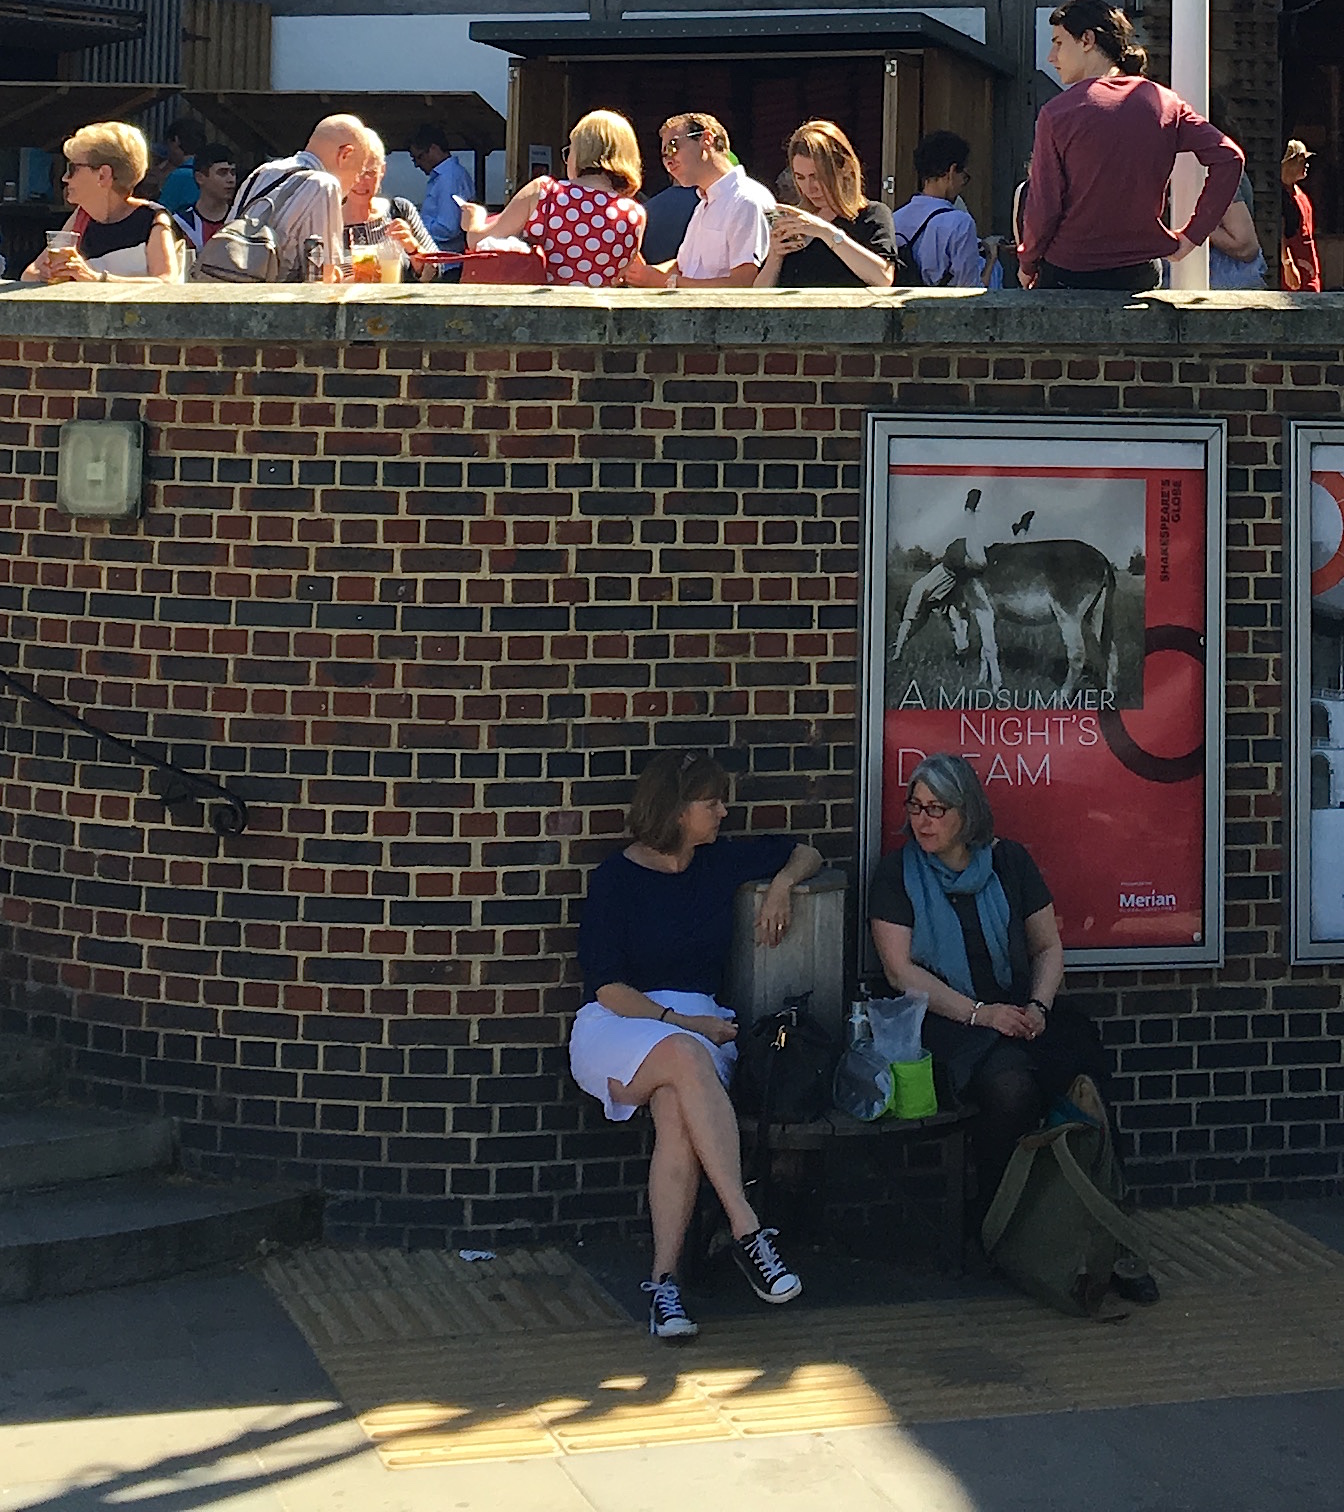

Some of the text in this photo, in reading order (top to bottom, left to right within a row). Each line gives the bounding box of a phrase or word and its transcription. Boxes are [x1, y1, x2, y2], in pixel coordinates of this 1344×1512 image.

[1171, 479, 1182, 523] GLOBE
[1160, 479, 1170, 583] SHAKESPEARE'S
[898, 679, 1116, 712] A MIDSUMMER
[959, 712, 1099, 746] NIGHT'S
[1119, 889, 1177, 908] Merian
